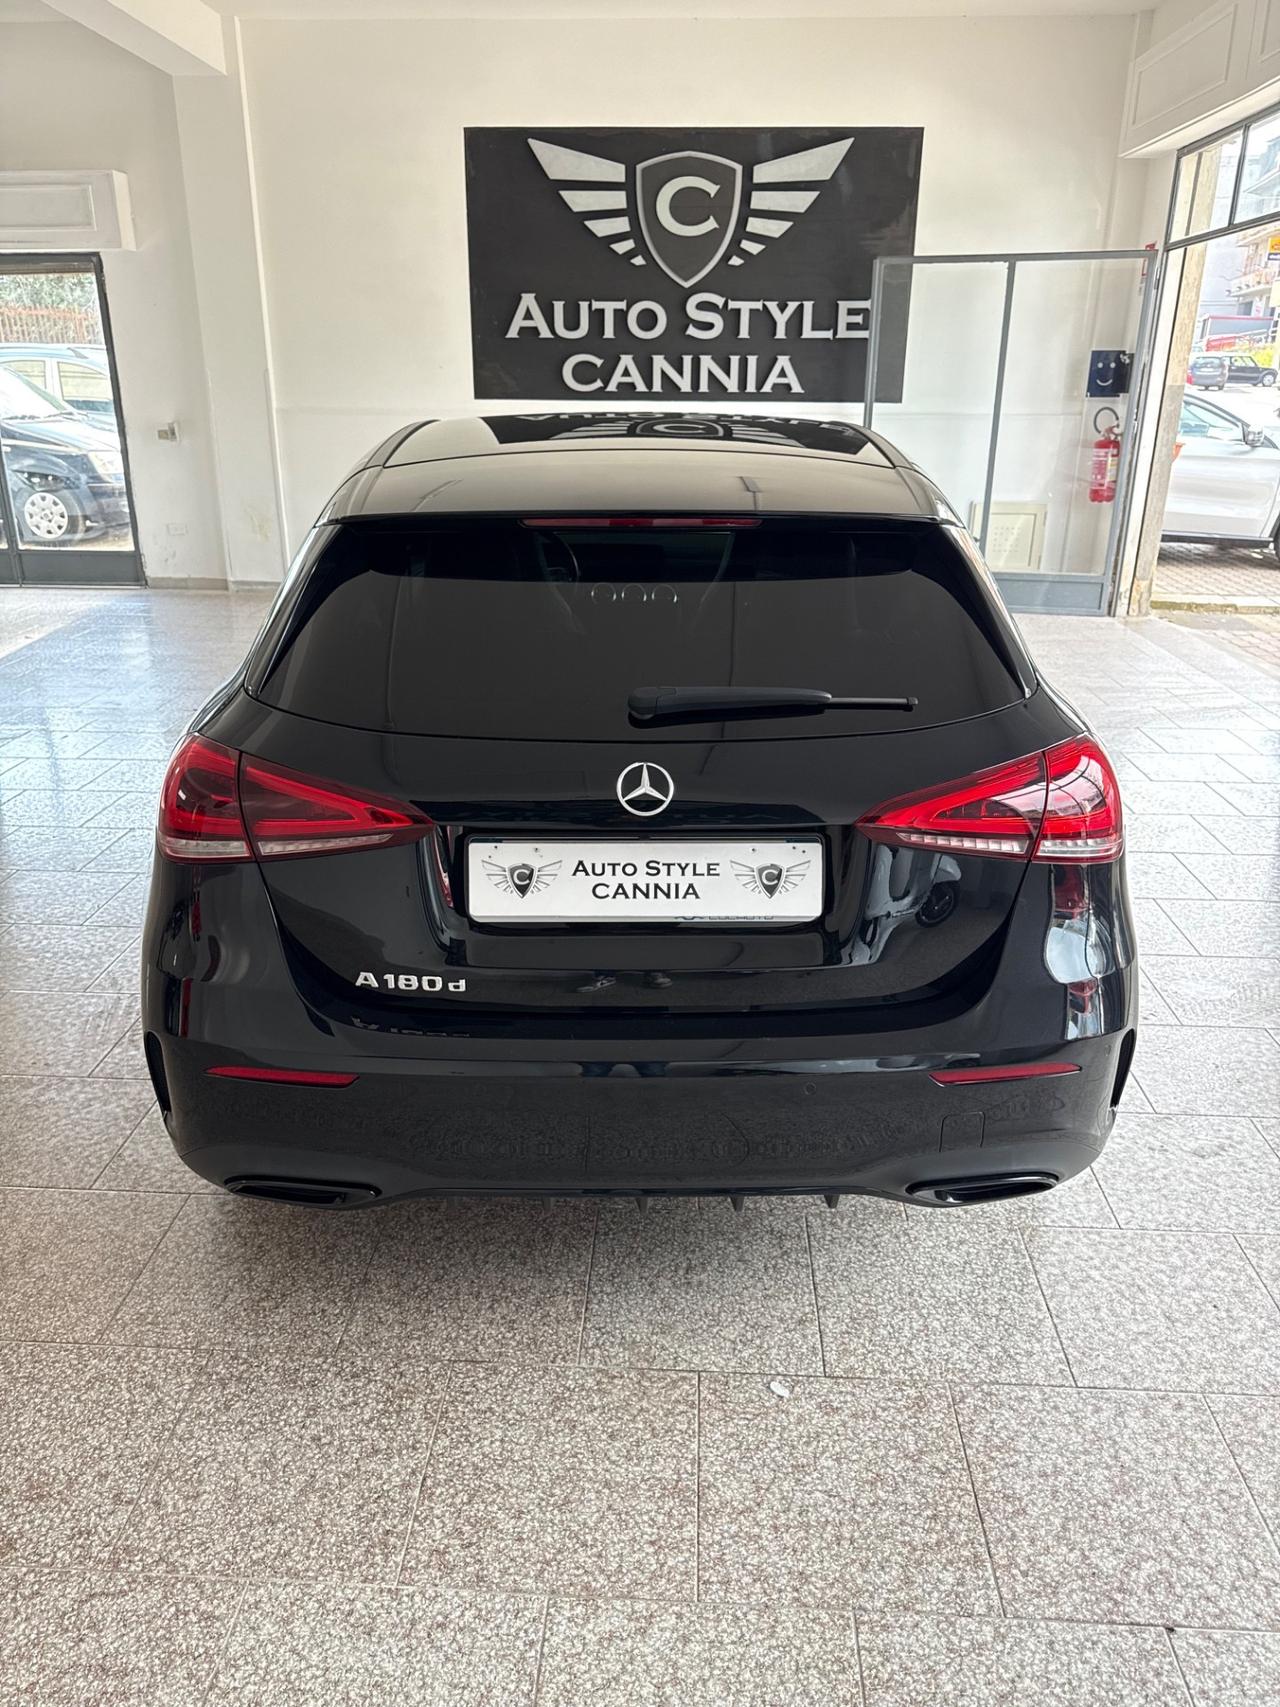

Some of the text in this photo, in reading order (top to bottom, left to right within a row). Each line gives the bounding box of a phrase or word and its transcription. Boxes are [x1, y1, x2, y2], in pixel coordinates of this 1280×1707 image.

[656, 176, 720, 236] C
[505, 293, 667, 340] AUTO
[562, 354, 805, 393] CANNIA
[572, 860, 720, 877] AUTO STYLE
[591, 882, 700, 900] CANNIA
